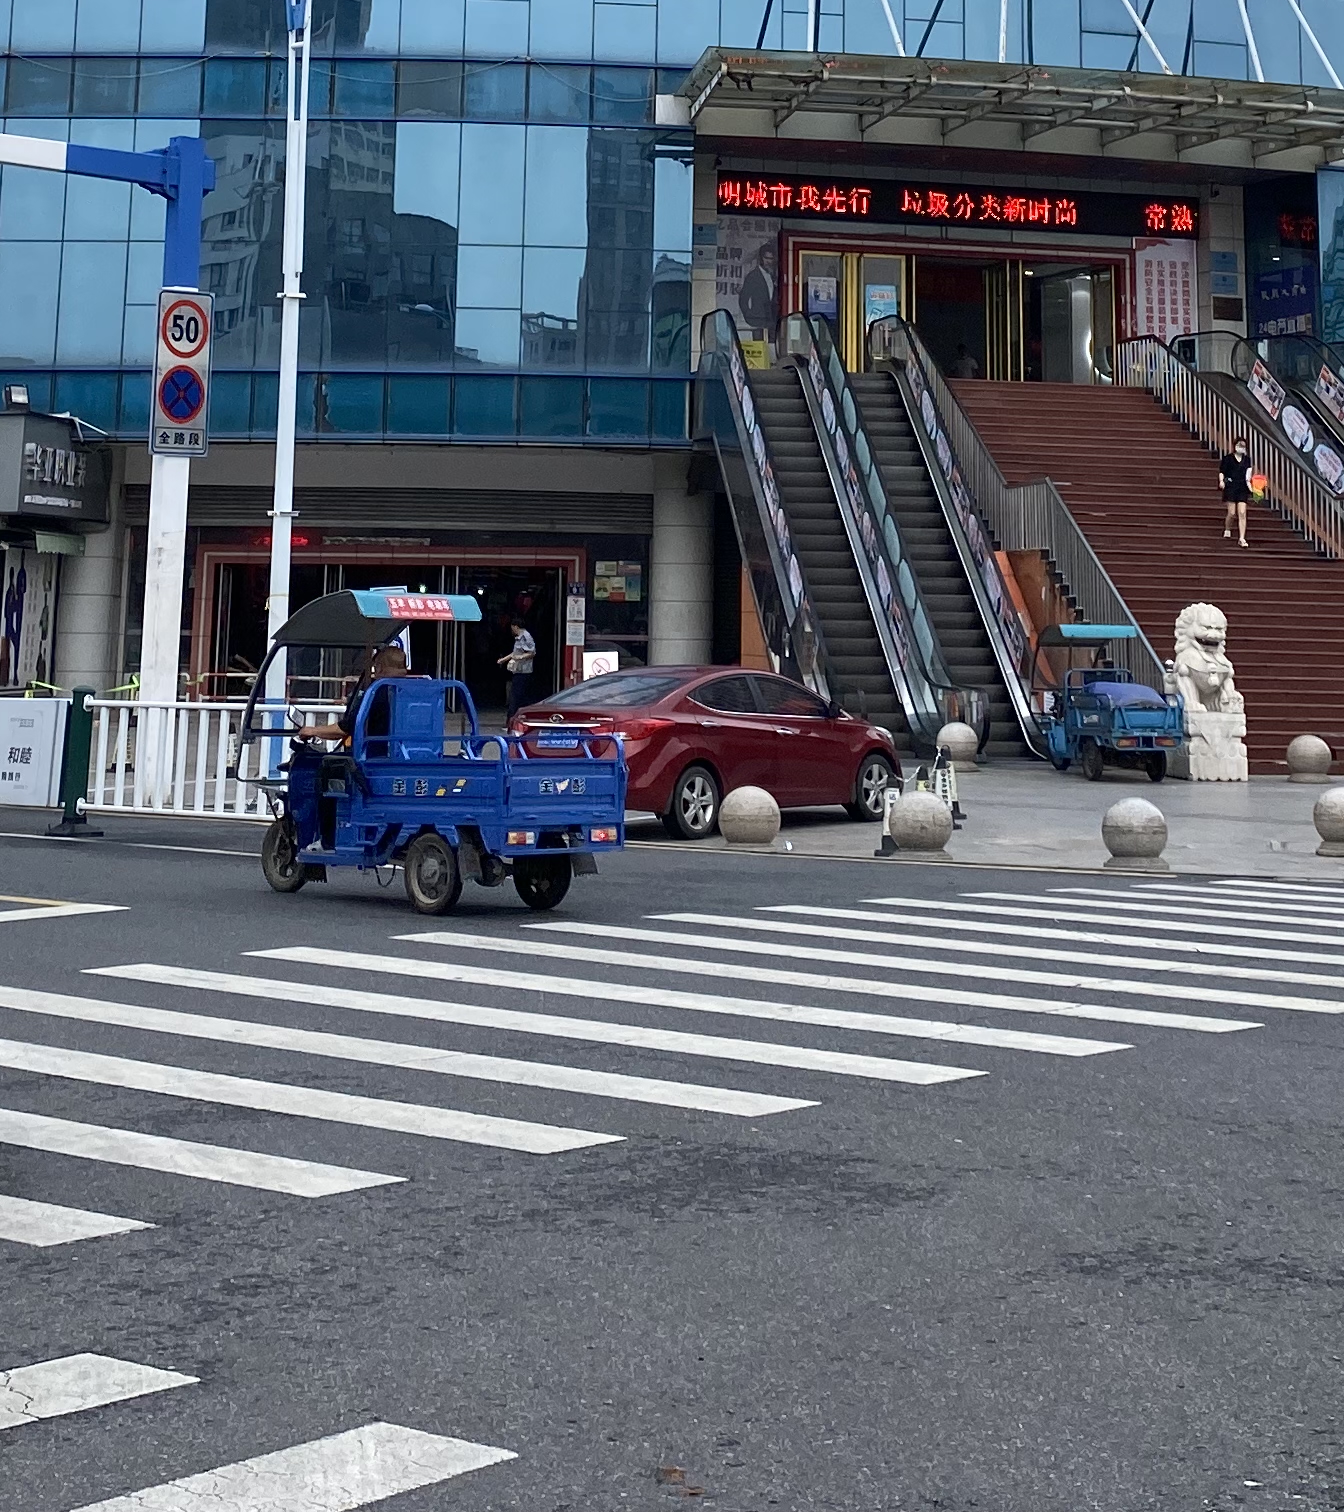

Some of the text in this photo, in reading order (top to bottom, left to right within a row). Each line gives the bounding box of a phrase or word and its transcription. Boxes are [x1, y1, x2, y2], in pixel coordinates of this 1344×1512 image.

[171, 314, 199, 344] 50
[158, 430, 200, 447] 全路段
